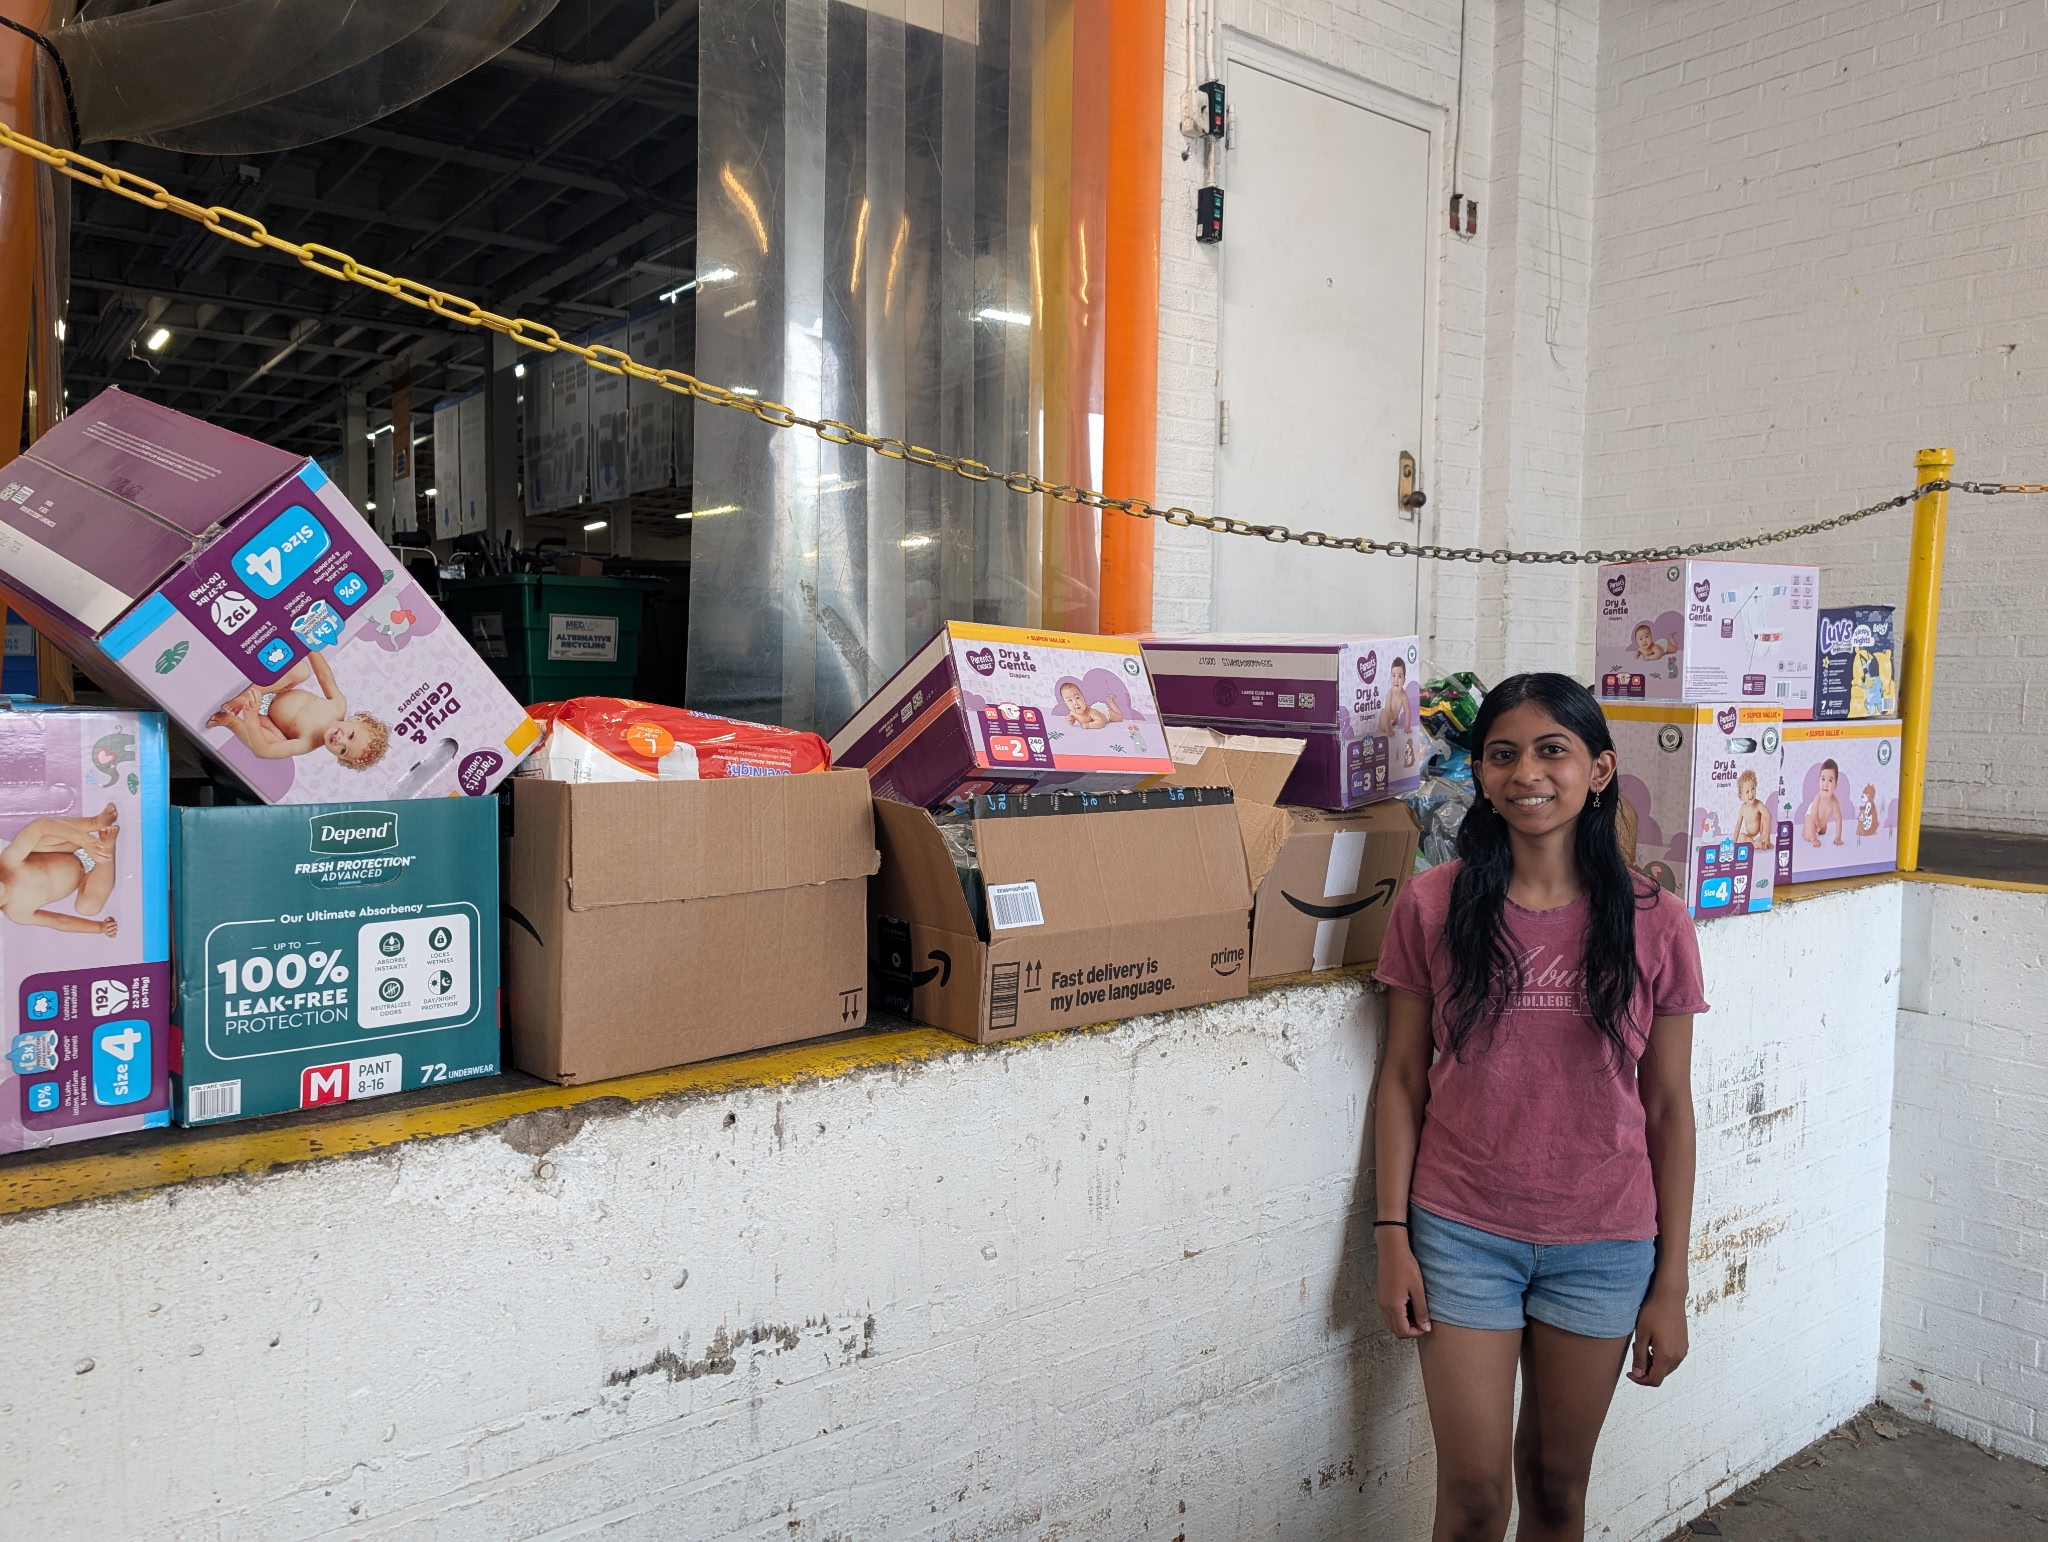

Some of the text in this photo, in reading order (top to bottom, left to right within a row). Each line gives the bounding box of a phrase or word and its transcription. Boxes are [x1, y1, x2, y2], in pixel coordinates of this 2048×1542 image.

[245, 525, 314, 586] Size 4
[313, 555, 337, 575] parabens
[313, 565, 337, 586] perfumes
[1610, 577, 1625, 590] Parent's
[189, 572, 222, 601] (10-17kg)
[196, 579, 229, 607] 22-37 lbs
[339, 579, 362, 599] 0%
[1696, 583, 1710, 593] Parent's
[284, 591, 306, 611] channels
[1606, 600, 1619, 609] Dry
[1691, 604, 1711, 614] Dry &
[224, 605, 251, 628] 192
[1603, 606, 1629, 616] Gentle
[1689, 613, 1713, 622] Gentle
[240, 625, 268, 649] breathable
[315, 623, 332, 638] 3x
[556, 634, 611, 643] ALTERNATIVE
[1855, 628, 1870, 638] sleepy
[246, 625, 278, 655] Cushiony soft
[1854, 636, 1871, 646] nights
[970, 654, 993, 665] Parent's
[1000, 649, 1032, 662] Dry &
[977, 662, 993, 672] CHOICE
[999, 660, 1037, 673] Gentle
[1360, 657, 1376, 673] Parent's
[398, 682, 430, 714] Diapers
[1357, 686, 1380, 701] Dry &
[394, 682, 453, 737] Gentle
[1354, 699, 1382, 713] Gentle
[1821, 701, 1827, 710] 7
[410, 698, 461, 745] Dry &
[1720, 712, 1736, 724] Parent's
[1723, 722, 1735, 730] CHOICE
[645, 738, 657, 754] L
[1010, 739, 1025, 758] 2
[462, 756, 483, 783] CHOICE
[466, 756, 497, 791] Parent's
[1714, 760, 1736, 772] Dry &
[1363, 773, 1372, 792] 3
[1712, 770, 1738, 781] Gentle
[321, 823, 388, 845] Depend
[295, 862, 335, 875] FRESH
[321, 868, 383, 882] ADVANCED
[1704, 889, 1716, 897] Size
[1716, 881, 1729, 902] 4
[281, 904, 424, 924] Our Ultimate Absorbency
[274, 942, 302, 951] UP TO
[377, 957, 406, 966] ABSORBS
[427, 958, 454, 966] WETNESS
[1211, 947, 1245, 968] prime
[217, 949, 350, 995] 100%
[375, 963, 408, 973] INSTANTLY
[1052, 957, 1159, 990] Fast delivery is
[96, 987, 109, 1011] 192
[142, 977, 150, 1009] (10-17kg)
[423, 995, 457, 1005] DAY/NIGHT
[1051, 976, 1176, 1013] my love language.
[63, 997, 71, 1021] Cushiony
[225, 988, 348, 1018] LEAK-FREE
[371, 1001, 412, 1012] NEUTRALIZES
[422, 1001, 458, 1011] PROTECTION
[1514, 995, 1572, 1008] COLLEGE
[380, 1009, 402, 1017] ODORS
[226, 1007, 348, 1036] PROTECTION
[101, 1028, 142, 1096] Size 4
[359, 1061, 392, 1077] PANT
[420, 1063, 495, 1084] 72 UNDERWEAR
[310, 1069, 343, 1102] M
[358, 1077, 385, 1094] 8-16
[38, 1085, 52, 1108] 0%
